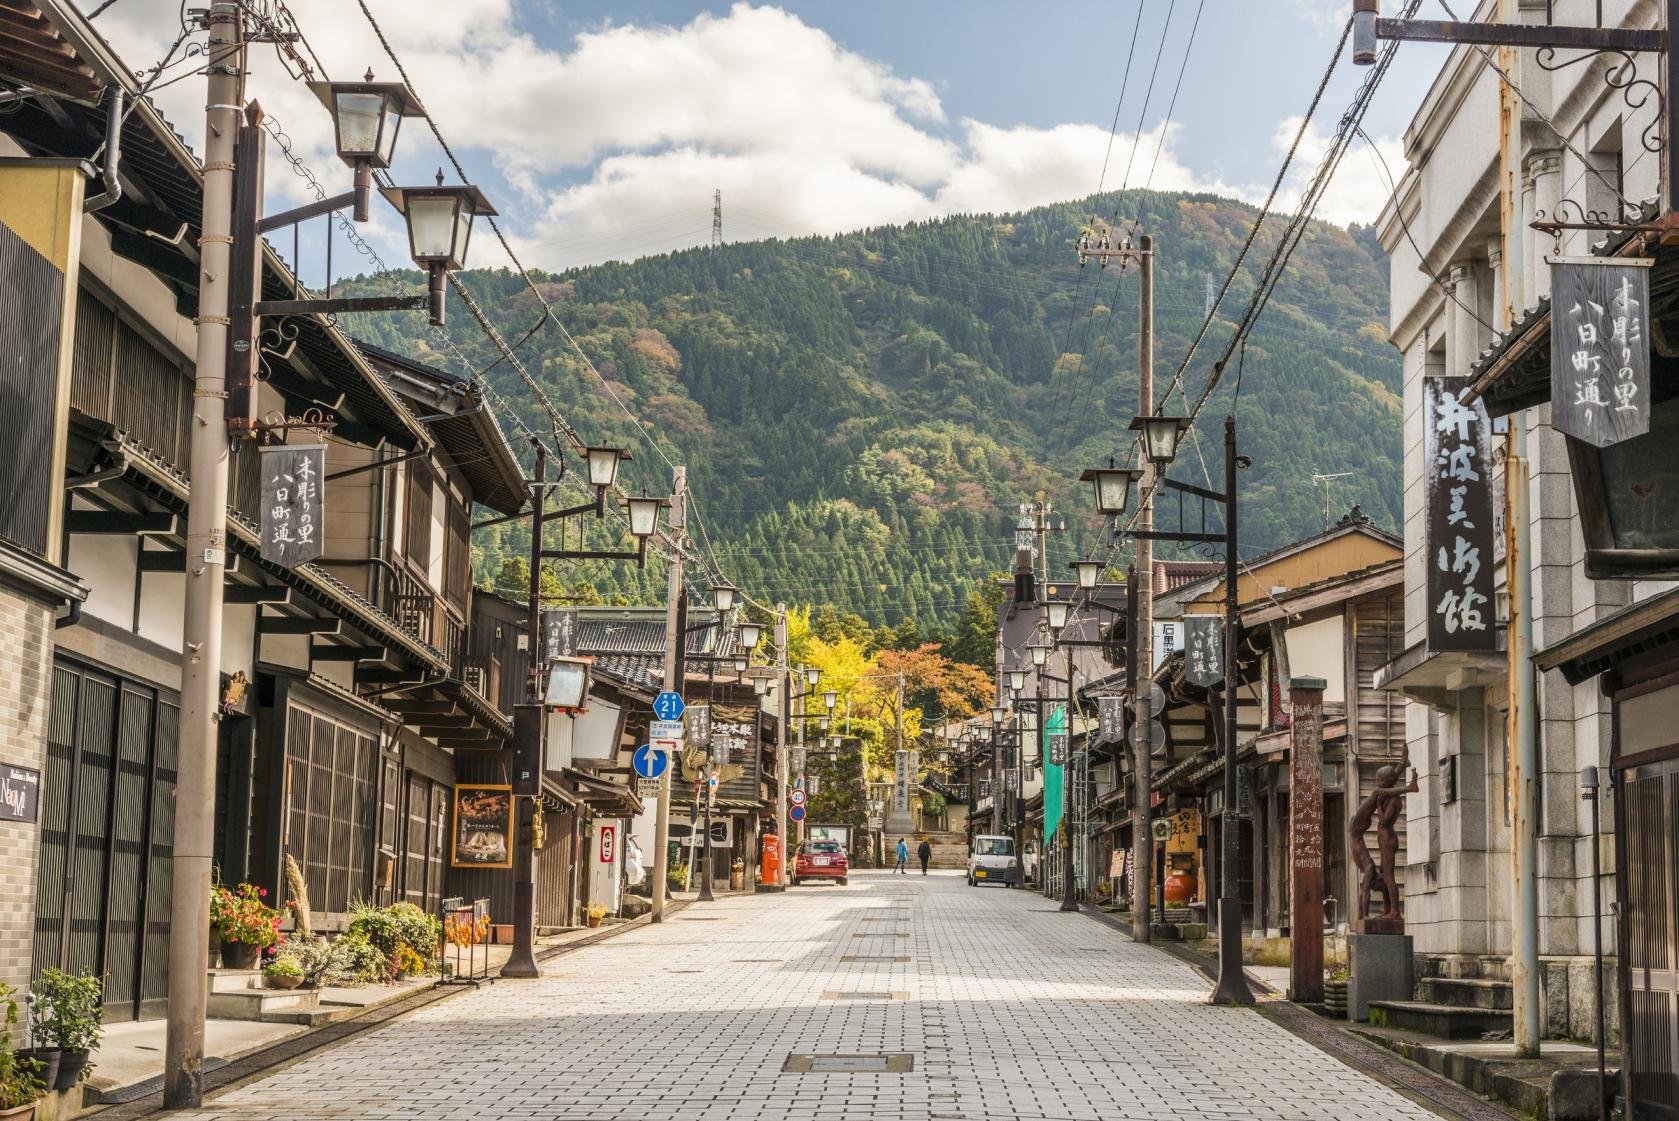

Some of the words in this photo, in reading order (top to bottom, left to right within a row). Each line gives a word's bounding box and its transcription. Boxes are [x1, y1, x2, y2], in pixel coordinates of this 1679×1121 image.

[1569, 300, 1610, 426] 八日町通り
[1611, 276, 1640, 411] 木彫りの里
[271, 473, 295, 556] 八日町通り
[297, 455, 316, 545] 木彫りの里
[1436, 387, 1487, 633] 井波美術館
[1190, 631, 1207, 680] 八日町通り
[1207, 620, 1219, 674] 木彫りの里
[661, 701, 676, 712] 21
[794, 793, 803, 802] 40
